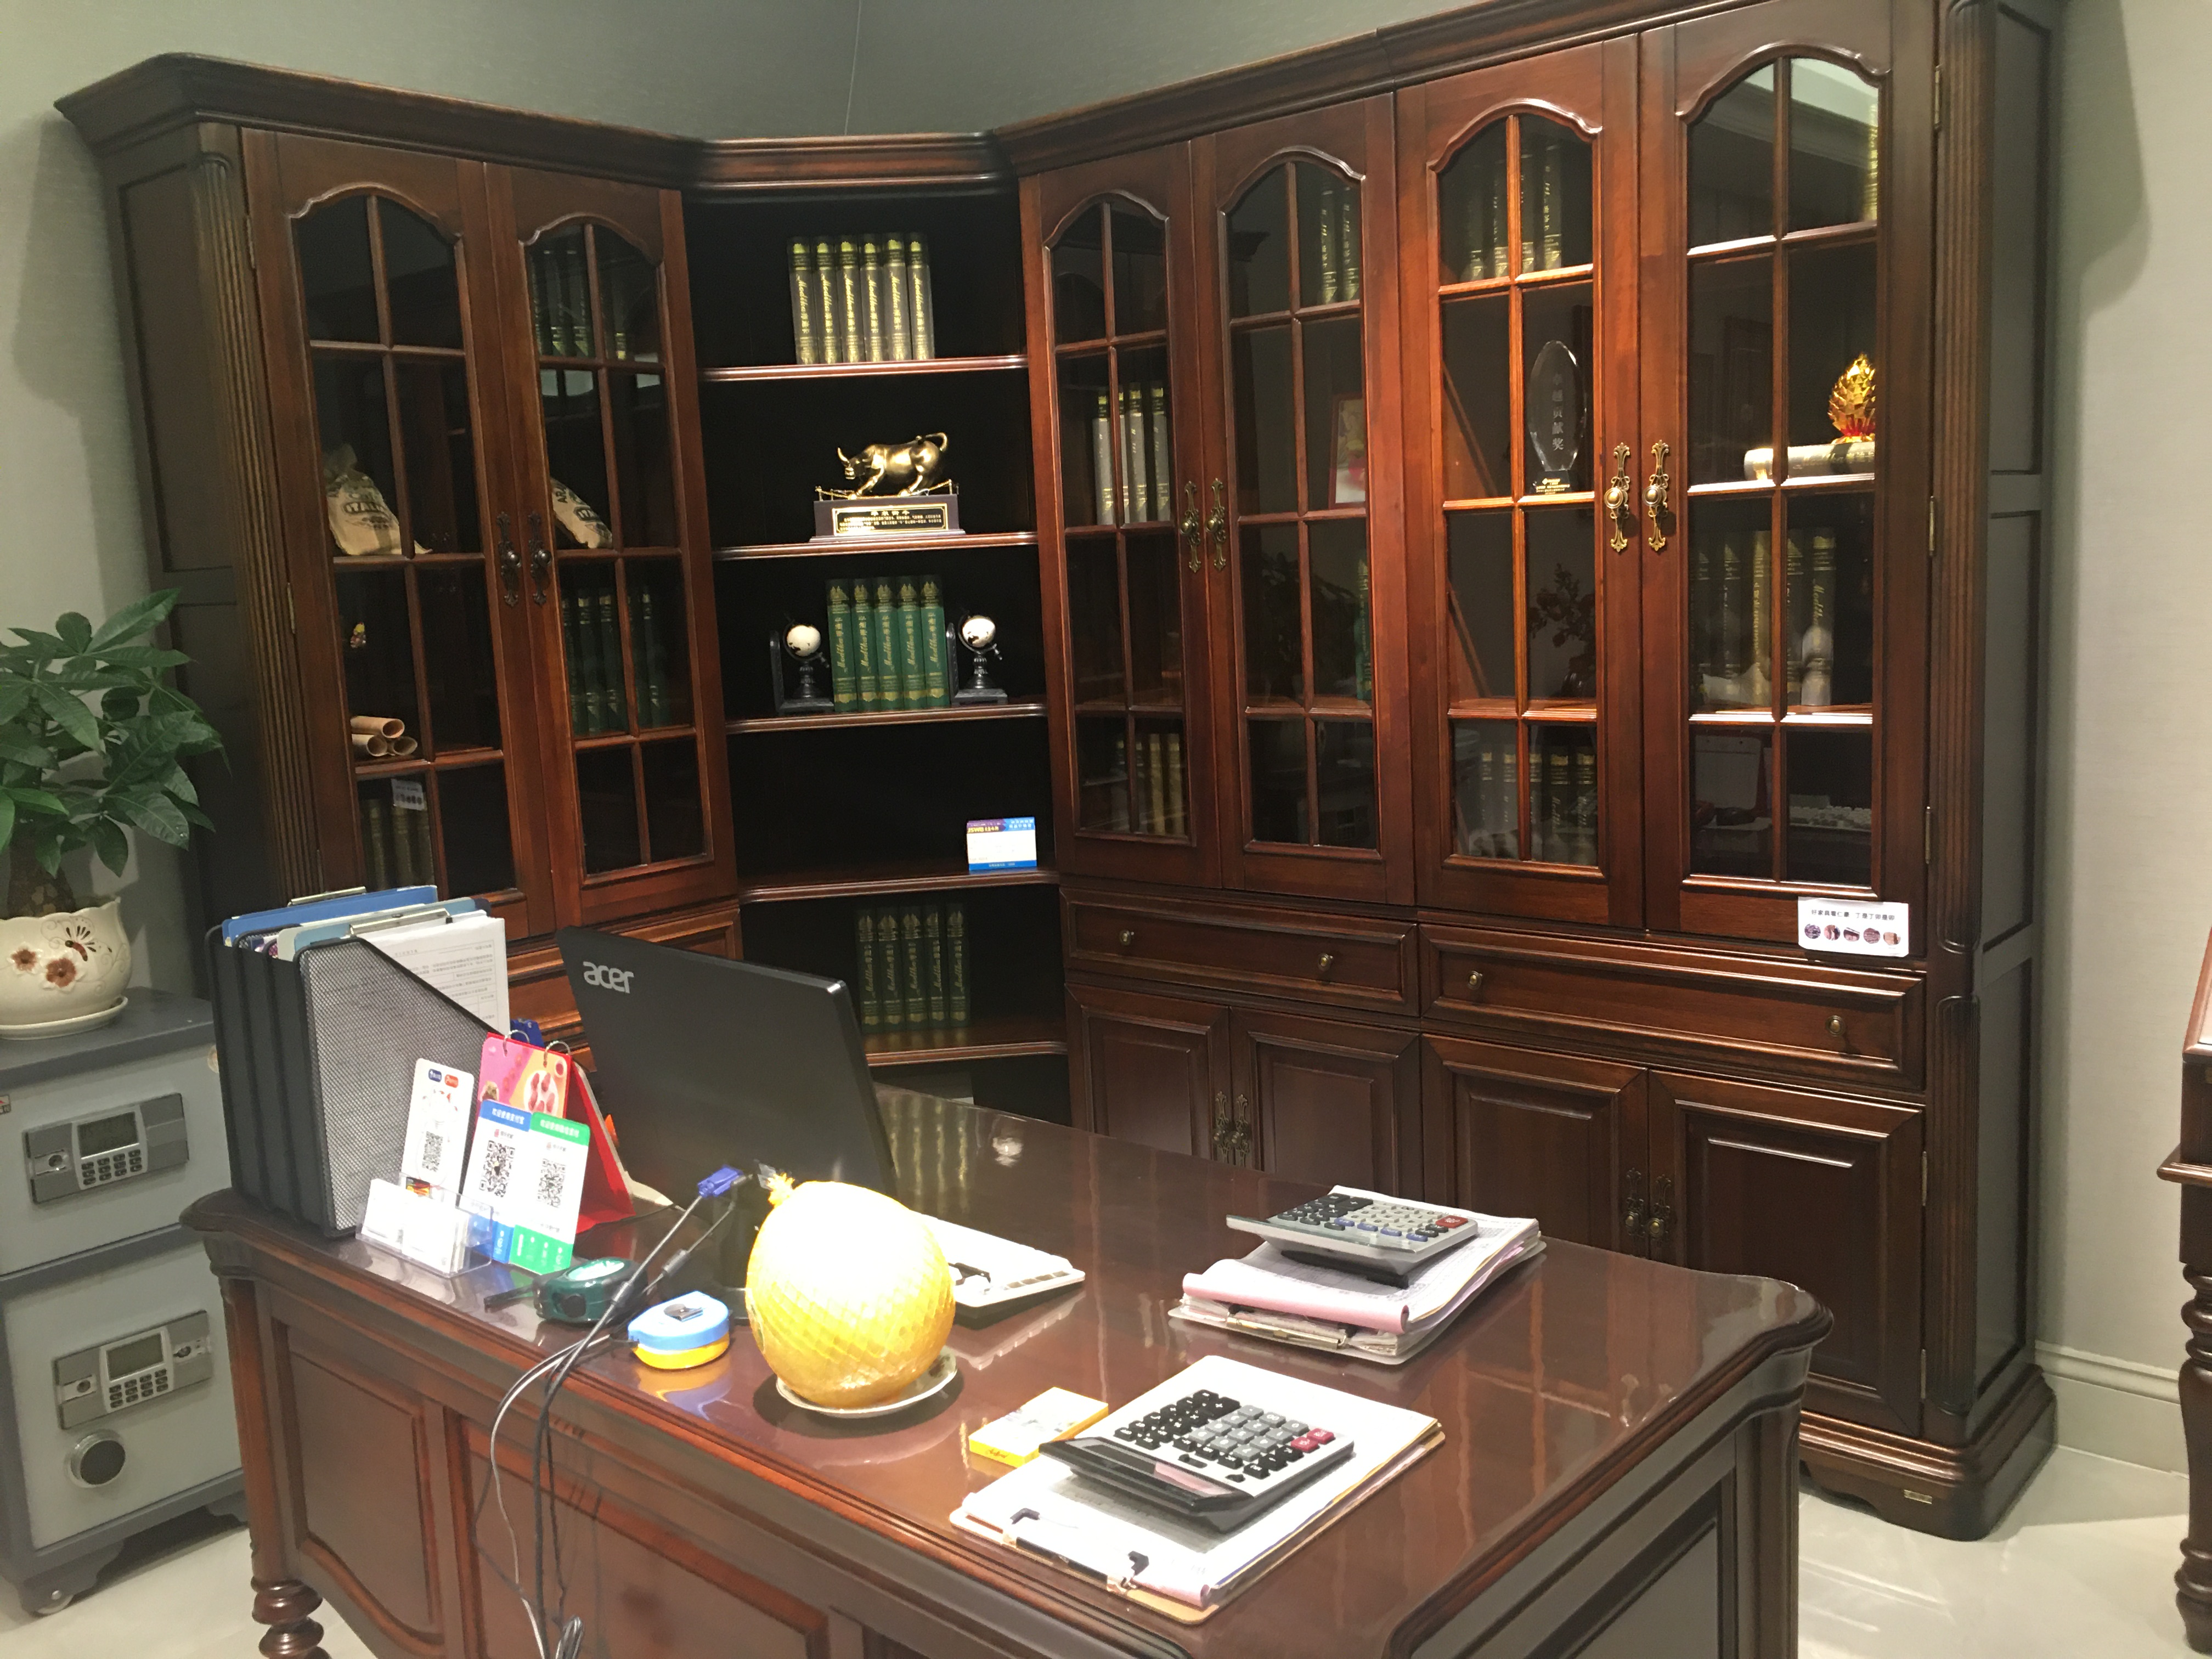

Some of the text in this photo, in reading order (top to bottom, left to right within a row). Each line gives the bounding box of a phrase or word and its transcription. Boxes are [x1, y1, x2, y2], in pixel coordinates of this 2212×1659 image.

[1855, 912, 1895, 921] 丁是丁卯是卯
[583, 961, 634, 994] acer
